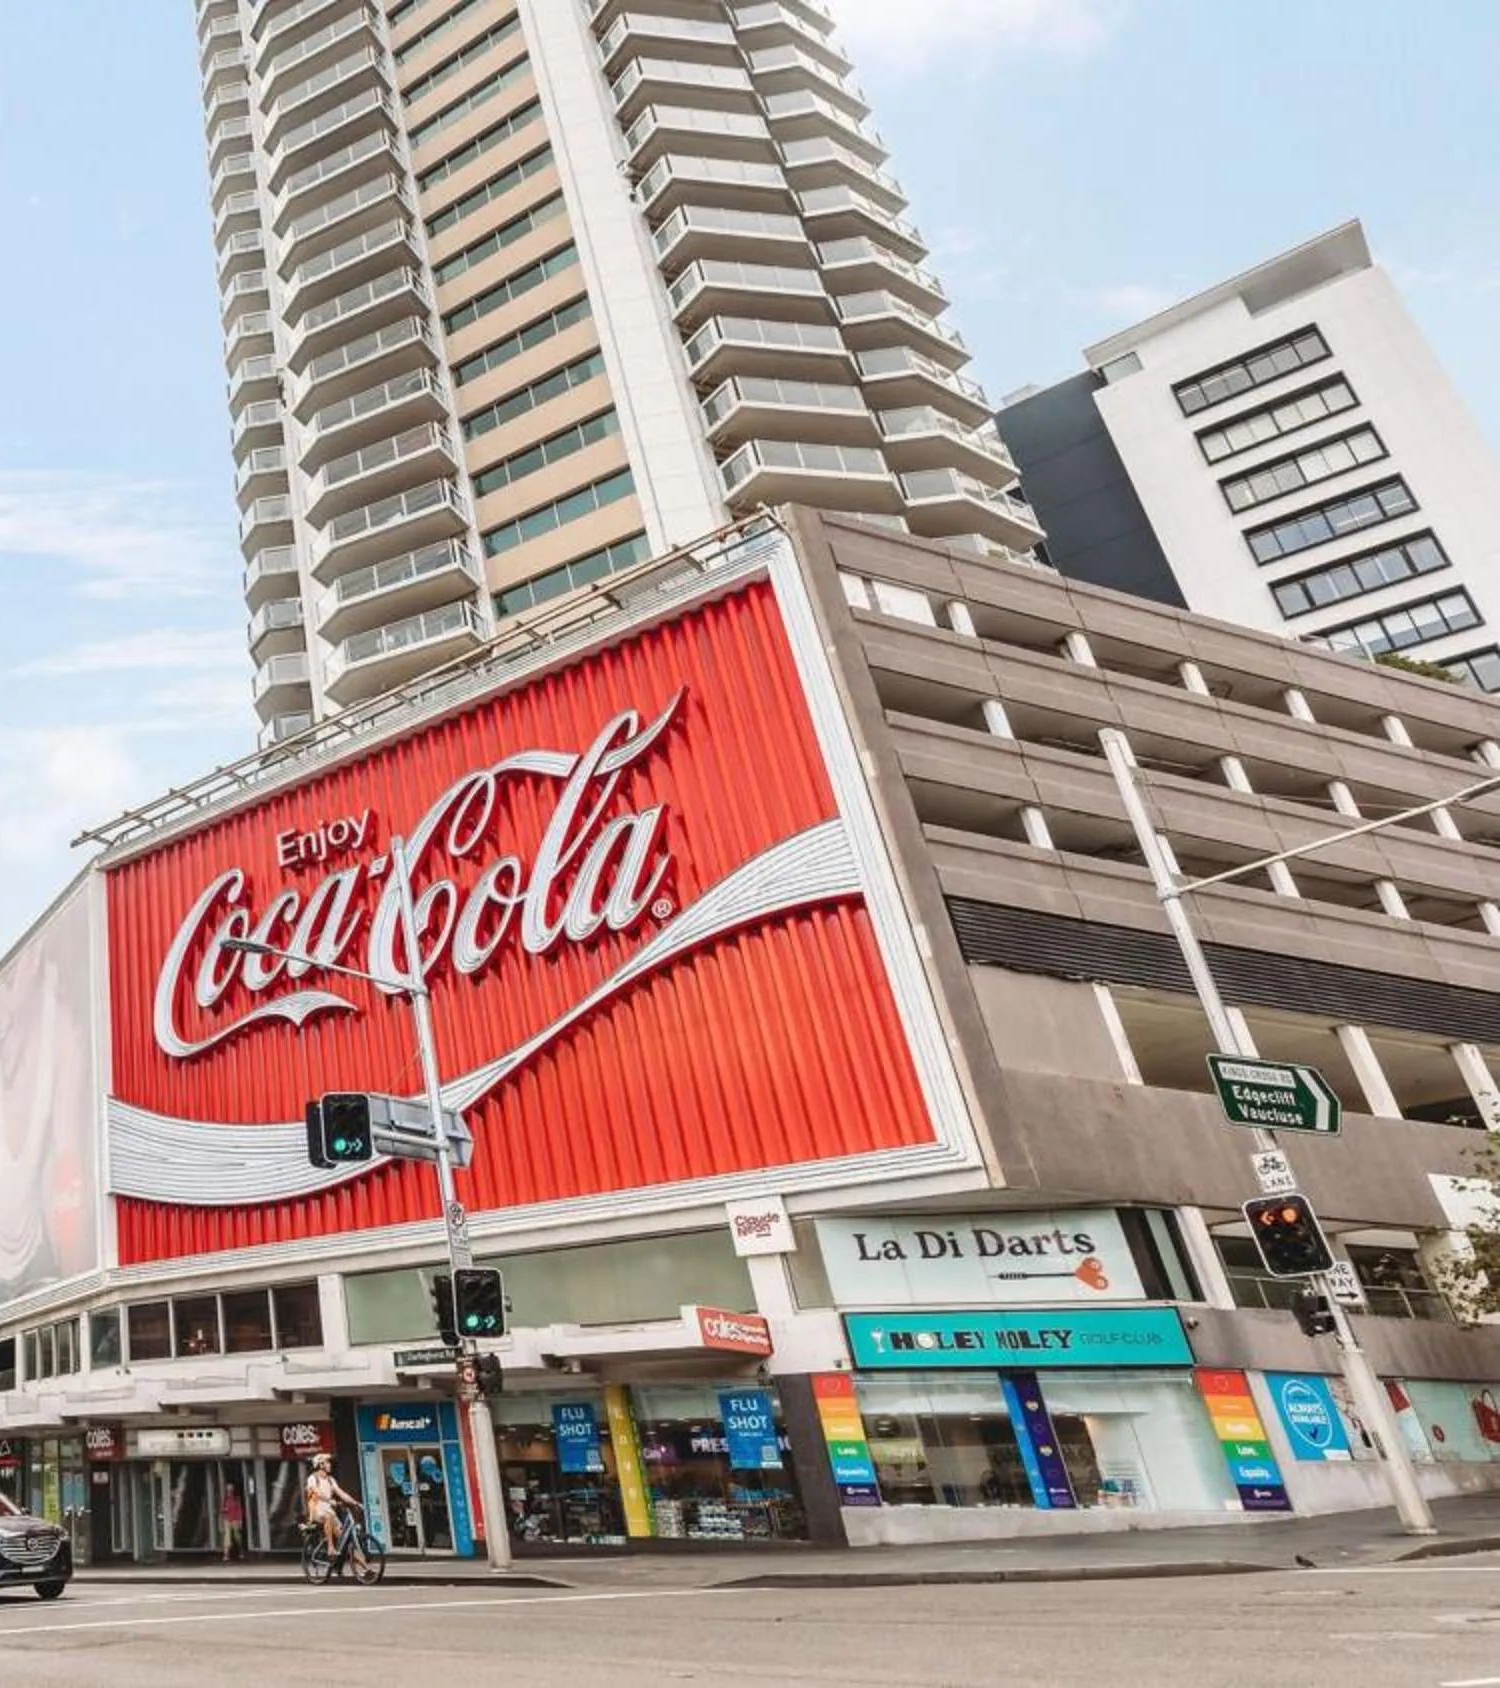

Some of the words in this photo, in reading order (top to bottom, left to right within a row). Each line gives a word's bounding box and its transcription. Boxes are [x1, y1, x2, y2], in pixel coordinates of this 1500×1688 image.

[276, 807, 369, 866] Enjoy
[153, 684, 688, 1058] Coca-Cola
[1231, 1084, 1297, 1106] Edgecliff
[1237, 1103, 1304, 1125] Vaucluse
[734, 1212, 780, 1227] Claude
[853, 1233, 907, 1261] La
[914, 1231, 964, 1259] Di
[972, 1229, 1096, 1257] Darts
[561, 1407, 585, 1420] FLU
[729, 1398, 757, 1412] FLU
[559, 1422, 592, 1437] SHOT
[729, 1415, 768, 1430] SHOT
